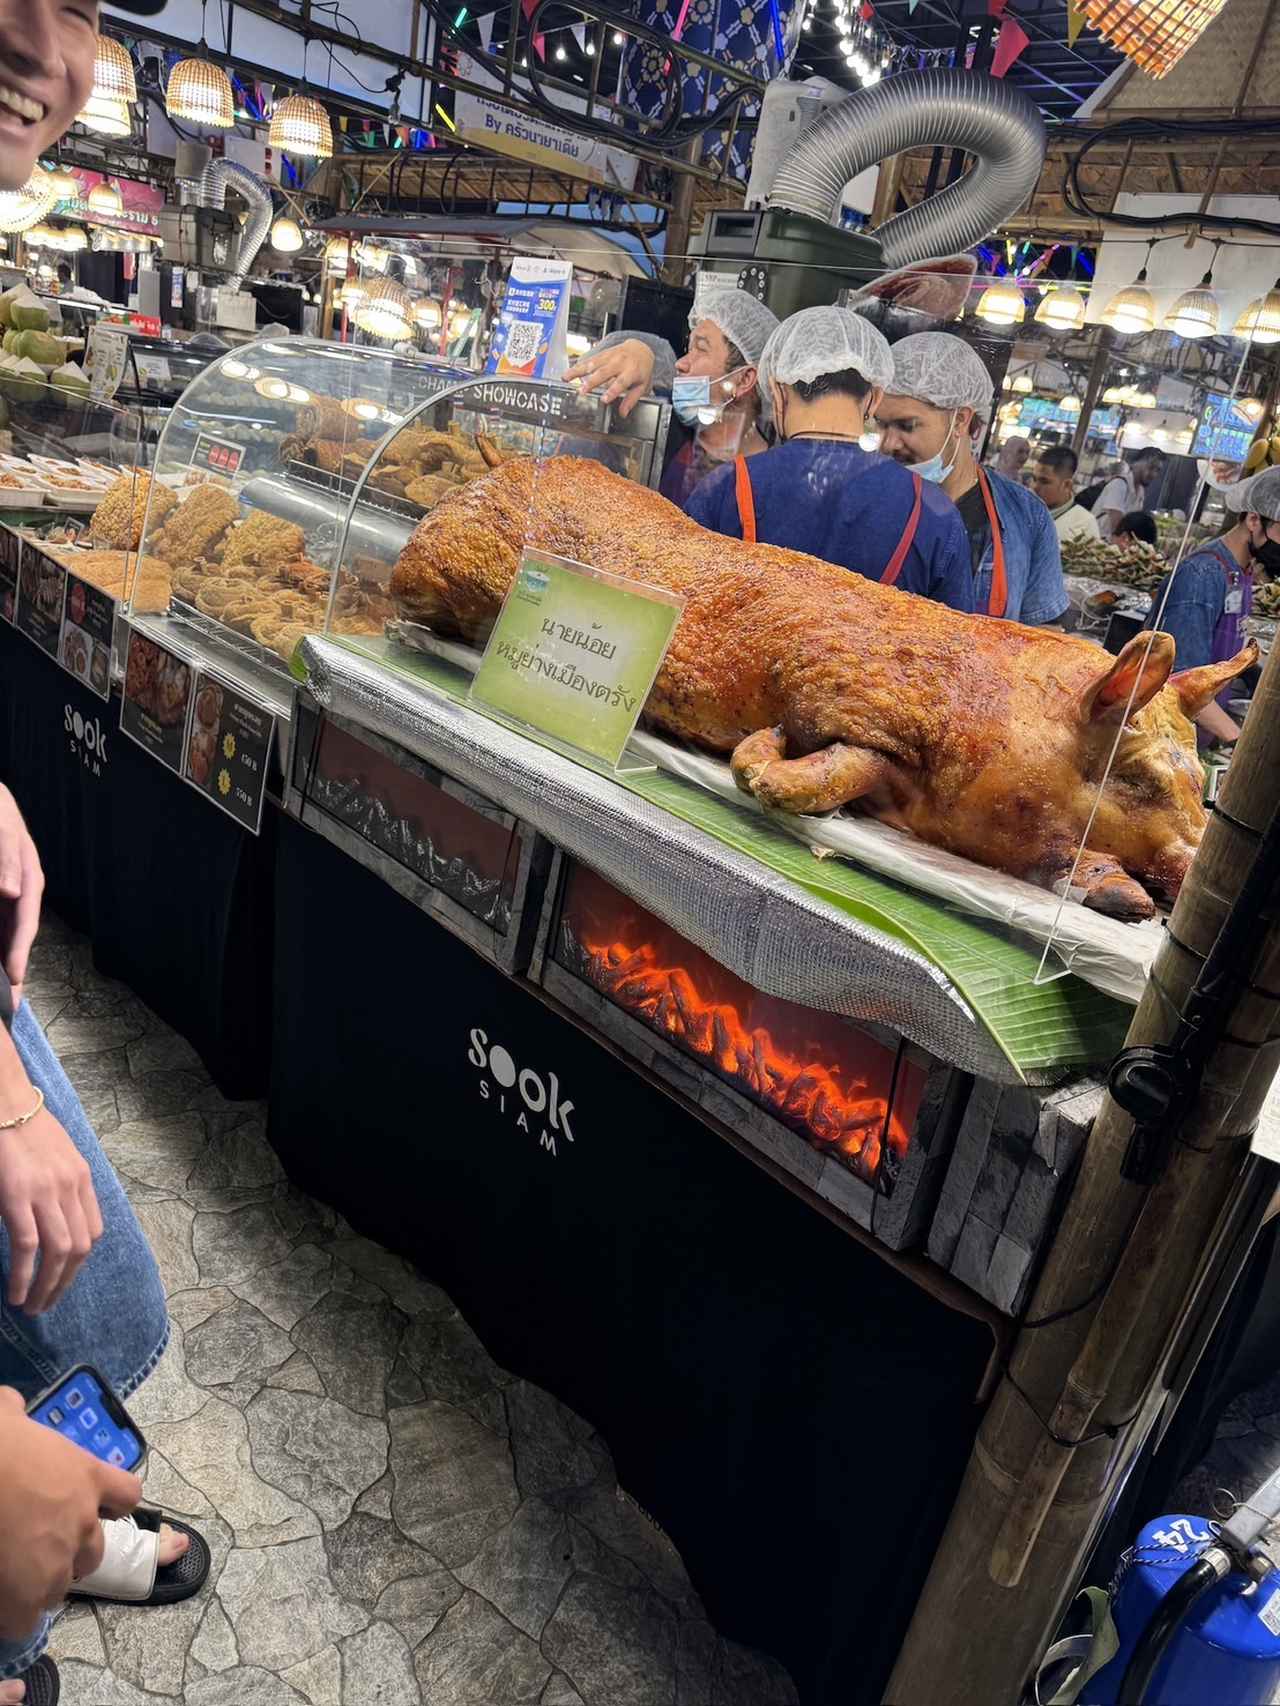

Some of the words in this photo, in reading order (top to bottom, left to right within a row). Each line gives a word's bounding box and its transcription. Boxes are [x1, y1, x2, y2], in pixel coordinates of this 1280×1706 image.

[485, 113, 502, 135] By
[473, 383, 562, 415] SHOWCASE
[541, 616, 615, 660] นายน้อย
[496, 640, 636, 712] หมูย่างเมืองตรัง
[479, 1079, 557, 1157] SIAM
[1152, 1518, 1210, 1554] 24
